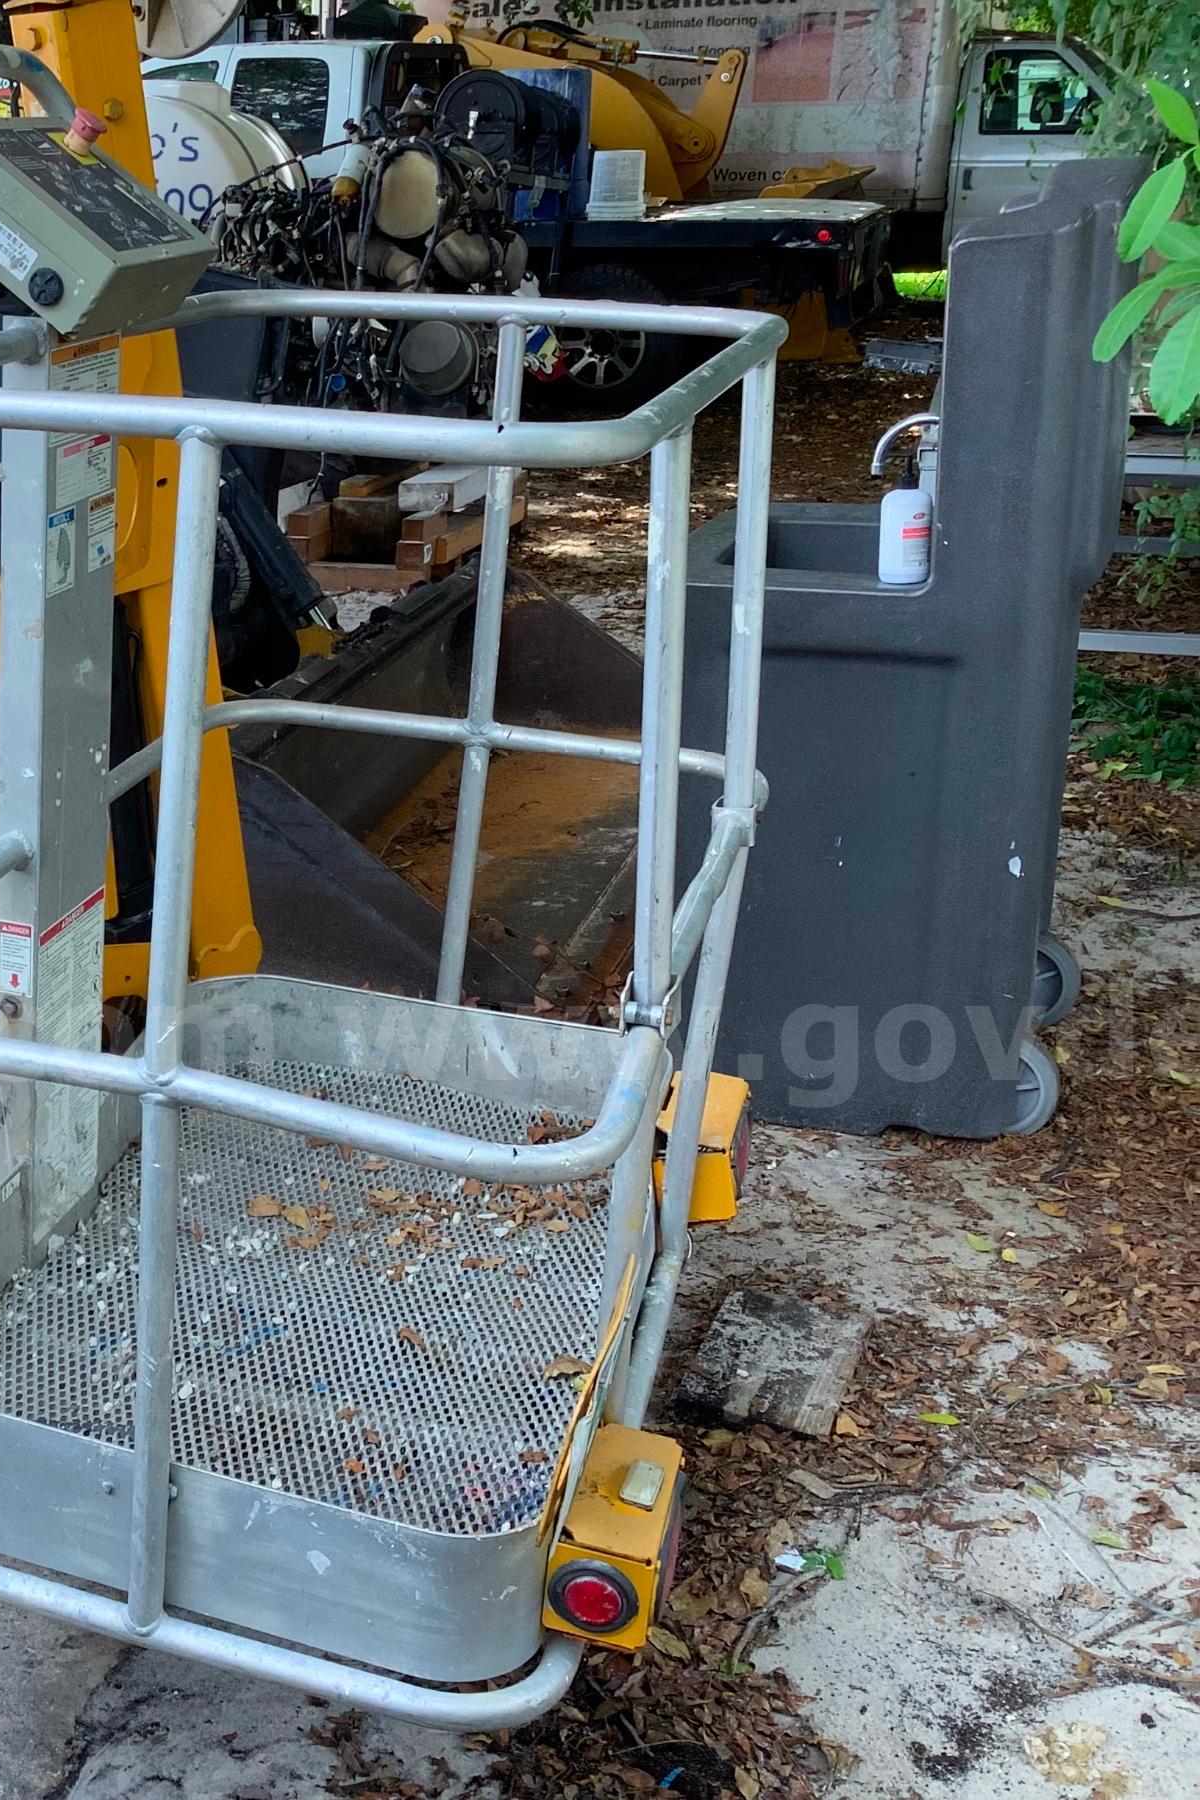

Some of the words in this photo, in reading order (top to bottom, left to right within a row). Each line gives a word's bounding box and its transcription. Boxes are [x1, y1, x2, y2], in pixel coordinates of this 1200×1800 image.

[593, 0, 798, 12] Instaa
[645, 17, 703, 31] Laminate
[707, 15, 758, 29] flooring
[658, 74, 702, 89] Carpet
[713, 167, 767, 182] Woven
[65, 905, 85, 926] DANGER
[6, 926, 31, 936] DANGER
